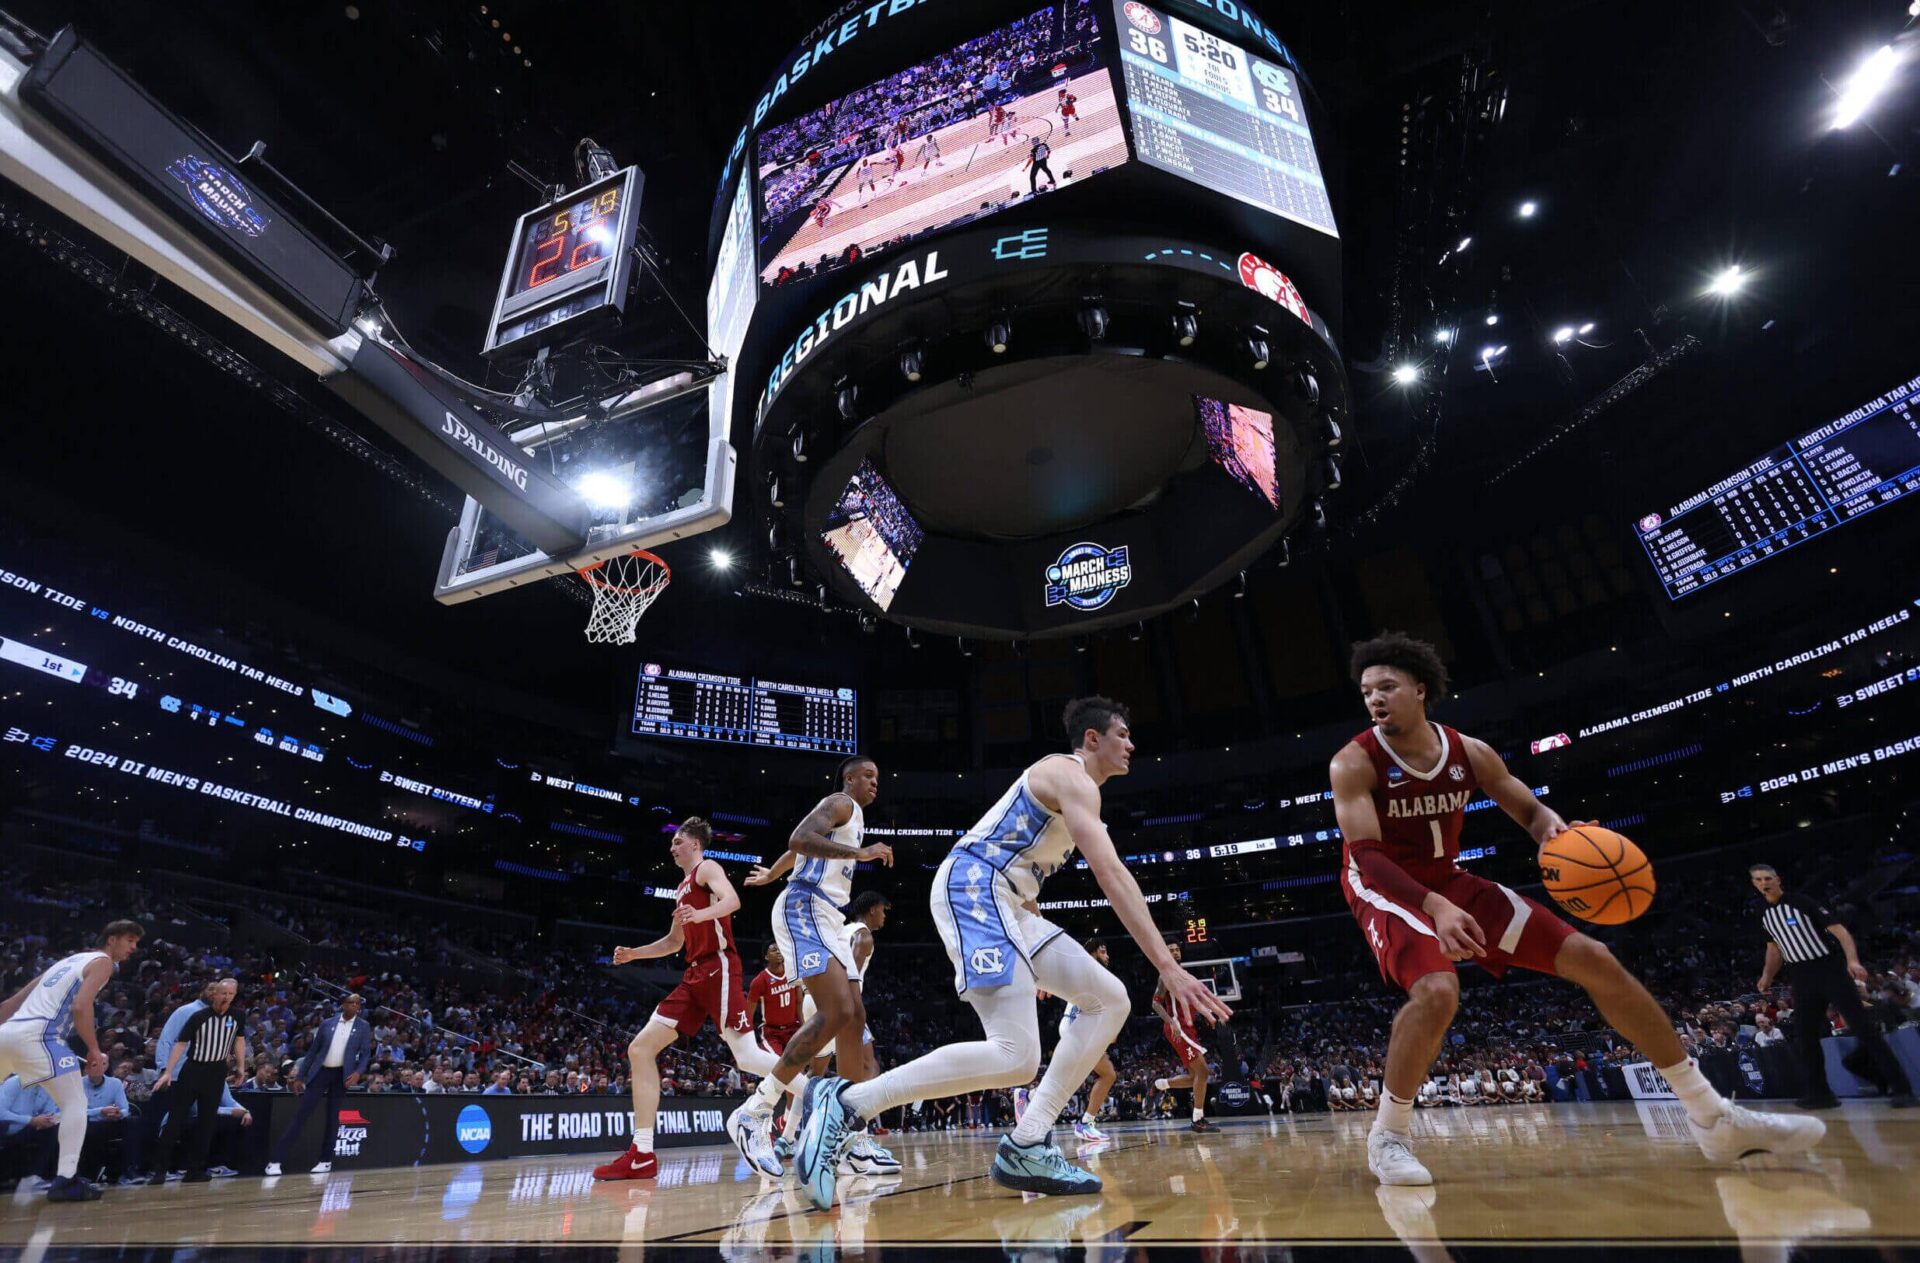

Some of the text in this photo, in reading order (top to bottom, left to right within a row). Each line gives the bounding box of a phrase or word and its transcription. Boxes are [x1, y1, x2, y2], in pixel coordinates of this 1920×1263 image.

[1128, 28, 1168, 63] 36
[1184, 33, 1237, 70] 5:20
[1200, 31, 1221, 47] 1st
[1262, 88, 1299, 122] 34
[552, 189, 618, 237] 5:19
[529, 217, 607, 288] 22
[766, 250, 949, 401] REGIONAL
[1797, 385, 1910, 449] NORTH CAROLINA TAR
[441, 411, 528, 493] SPALDING
[1818, 446, 1846, 465] C.RYAN
[1824, 453, 1855, 473] R.DAVIS
[1830, 461, 1862, 482] A.BACOT
[1836, 469, 1873, 491] P.WOJCIK
[1669, 456, 1774, 517] ALABAMA CRIMSON TIDE
[1842, 475, 1882, 499] H.INGRAM
[1843, 494, 1869, 509] TEAM
[1880, 488, 1901, 502] 48.0
[1847, 500, 1875, 516] STATS
[1657, 528, 1684, 546] M.SEARS
[1666, 543, 1697, 562] R.GRIFFEN
[1061, 556, 1105, 579] MARCH
[1069, 566, 1129, 592] MADNESS
[1674, 559, 1707, 578] A.ESTRADA
[1675, 575, 1695, 587] TEAM
[1702, 571, 1718, 583] 50.0
[1677, 581, 1699, 594] STATS
[43, 587, 86, 611] TIDE
[111, 615, 166, 642] NORTH
[167, 637, 238, 672] CAROLINA
[239, 664, 265, 681] TAR
[266, 675, 304, 697] HEELS
[41, 658, 138, 700] 1st 34
[667, 669, 834, 697] ALABAMA CRIMSON TIDE NORTH CAROLINA TAR HEELS
[1579, 715, 1630, 739] ALABAMA
[1631, 698, 1684, 723] CRIMSON
[1684, 687, 1713, 705] TIDE
[1732, 665, 1773, 688] NORTH
[1775, 640, 1842, 673] CAROLINA
[1842, 628, 1868, 646] TAR
[1868, 609, 1910, 635] HEELS
[1855, 673, 1905, 702] SWEET
[190, 711, 198, 720] 4
[300, 748, 324, 762] 100.0
[1759, 735, 1920, 793] 2024 DI MEN'S BASKE
[64, 744, 393, 843] 2024 DI MEN'S BASKETBALL CHAMPIONSHIP
[393, 776, 482, 810] SWEET SIXTEEN
[546, 775, 624, 803] WEST REGIONAL
[1295, 793, 1322, 805] WEST
[897, 828, 934, 836] CRIMSON
[1429, 820, 1445, 859] 1
[1185, 848, 1201, 860] 36
[1214, 844, 1239, 857] 5:19
[1287, 834, 1304, 846] 34
[1186, 927, 1208, 943] 22
[1187, 918, 1206, 928] 5:19
[779, 991, 791, 1008] 10
[1633, 1067, 1657, 1094] WEST
[459, 1127, 491, 1142] NCAA
[519, 1112, 554, 1141] THE
[557, 1111, 602, 1139] ROAD
[604, 1110, 625, 1136] TO
[655, 1110, 691, 1134] FINAL
[693, 1109, 724, 1132] FOUR
[333, 1139, 361, 1158] Hut
